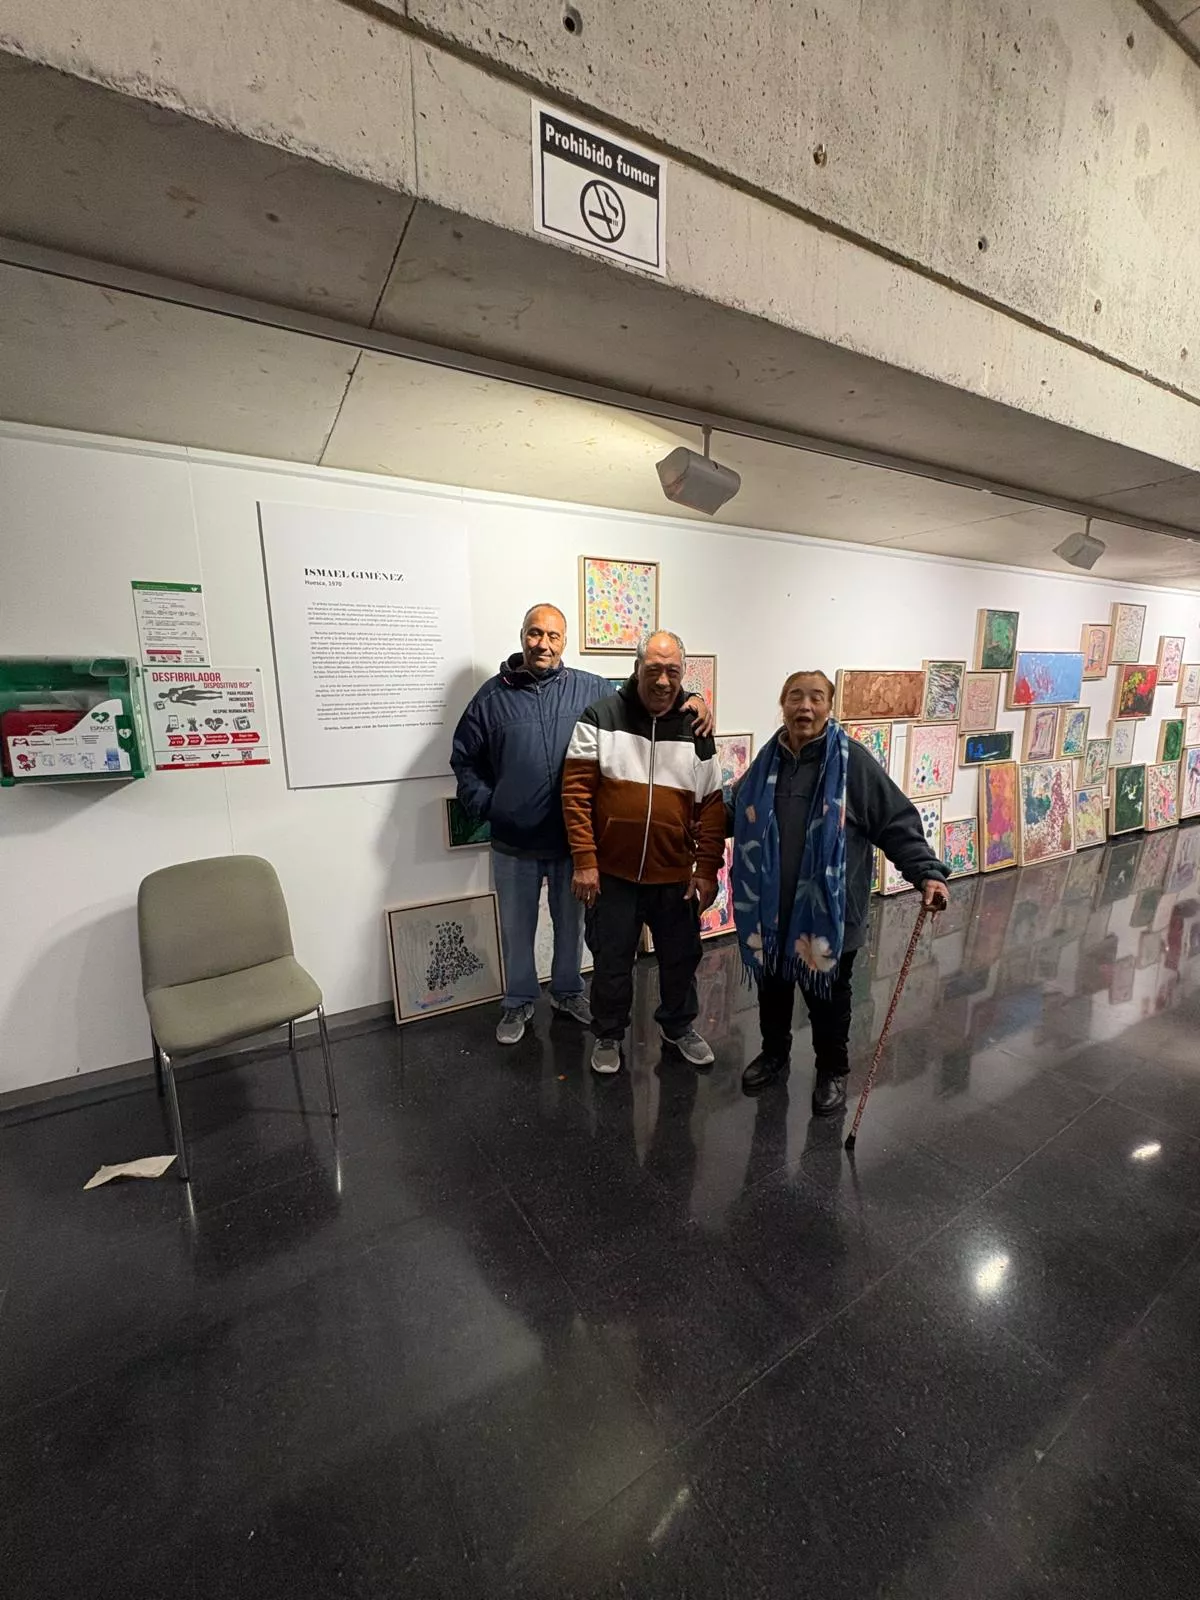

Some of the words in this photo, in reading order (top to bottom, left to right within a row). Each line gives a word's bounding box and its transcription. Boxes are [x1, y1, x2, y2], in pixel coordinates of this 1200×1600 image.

[545, 123, 613, 170] Prohibido
[616, 155, 656, 187] fumar
[304, 568, 349, 578] ISMAEL
[351, 570, 404, 581] GIMÉNEZ
[152, 672, 221, 682] DESFIBRILADOR
